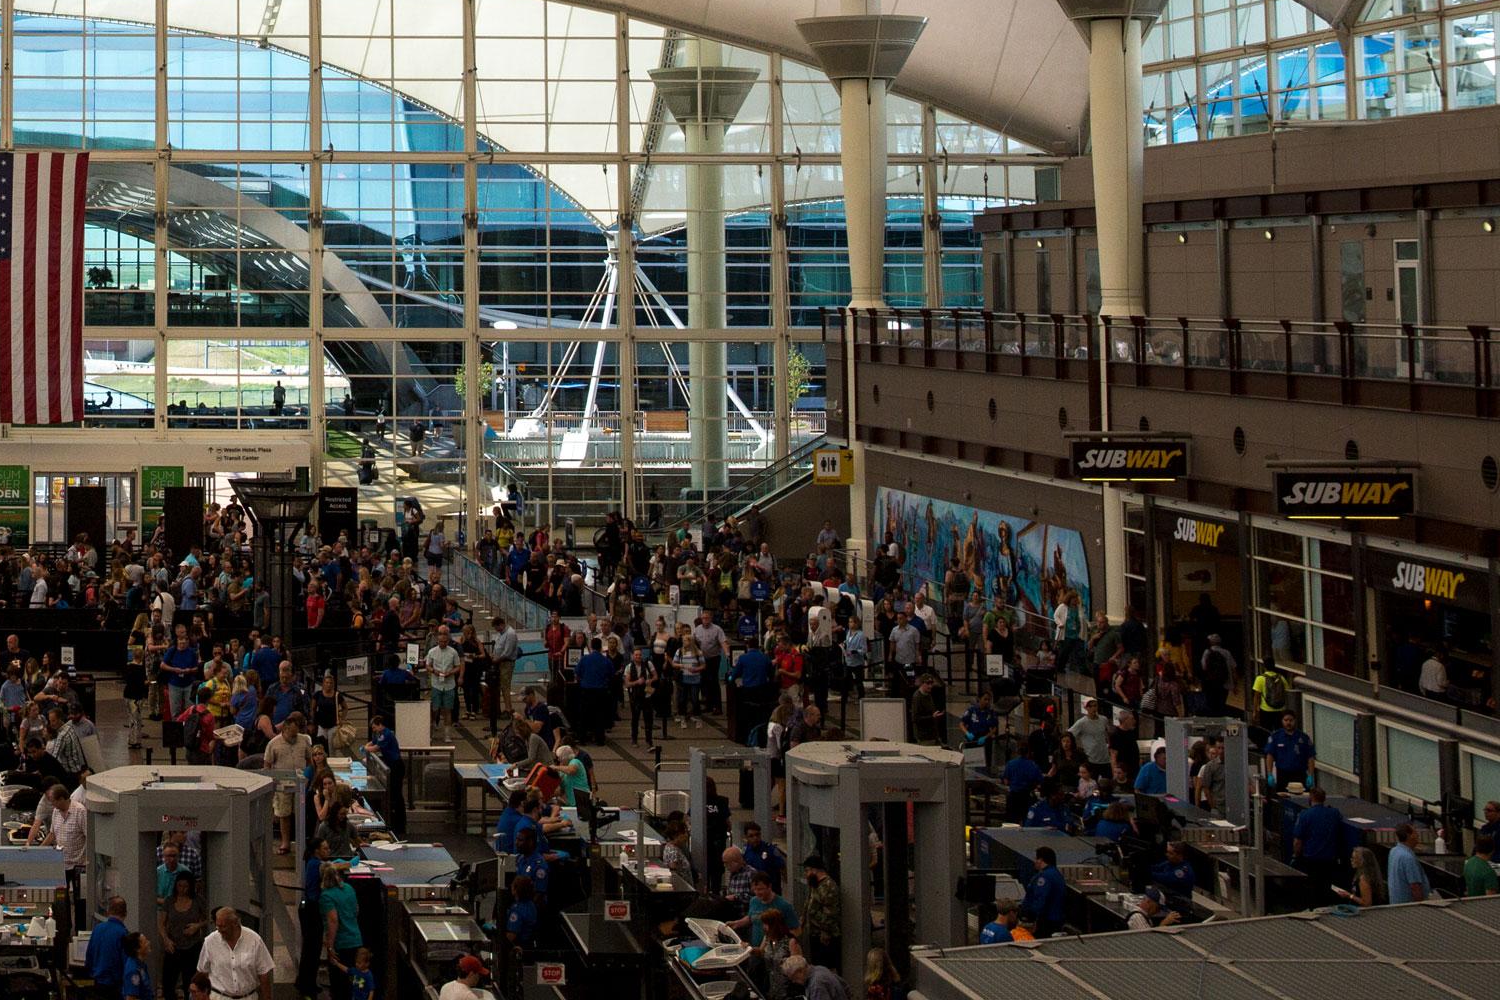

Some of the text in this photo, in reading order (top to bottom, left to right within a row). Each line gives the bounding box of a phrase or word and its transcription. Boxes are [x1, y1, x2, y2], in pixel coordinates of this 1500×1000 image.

[1077, 448, 1183, 470] SUBWAY
[150, 470, 175, 480] SUM
[1281, 481, 1410, 506] SUBWAY
[1173, 516, 1227, 548] SUBWAY
[1391, 561, 1467, 600] SUBWAY
